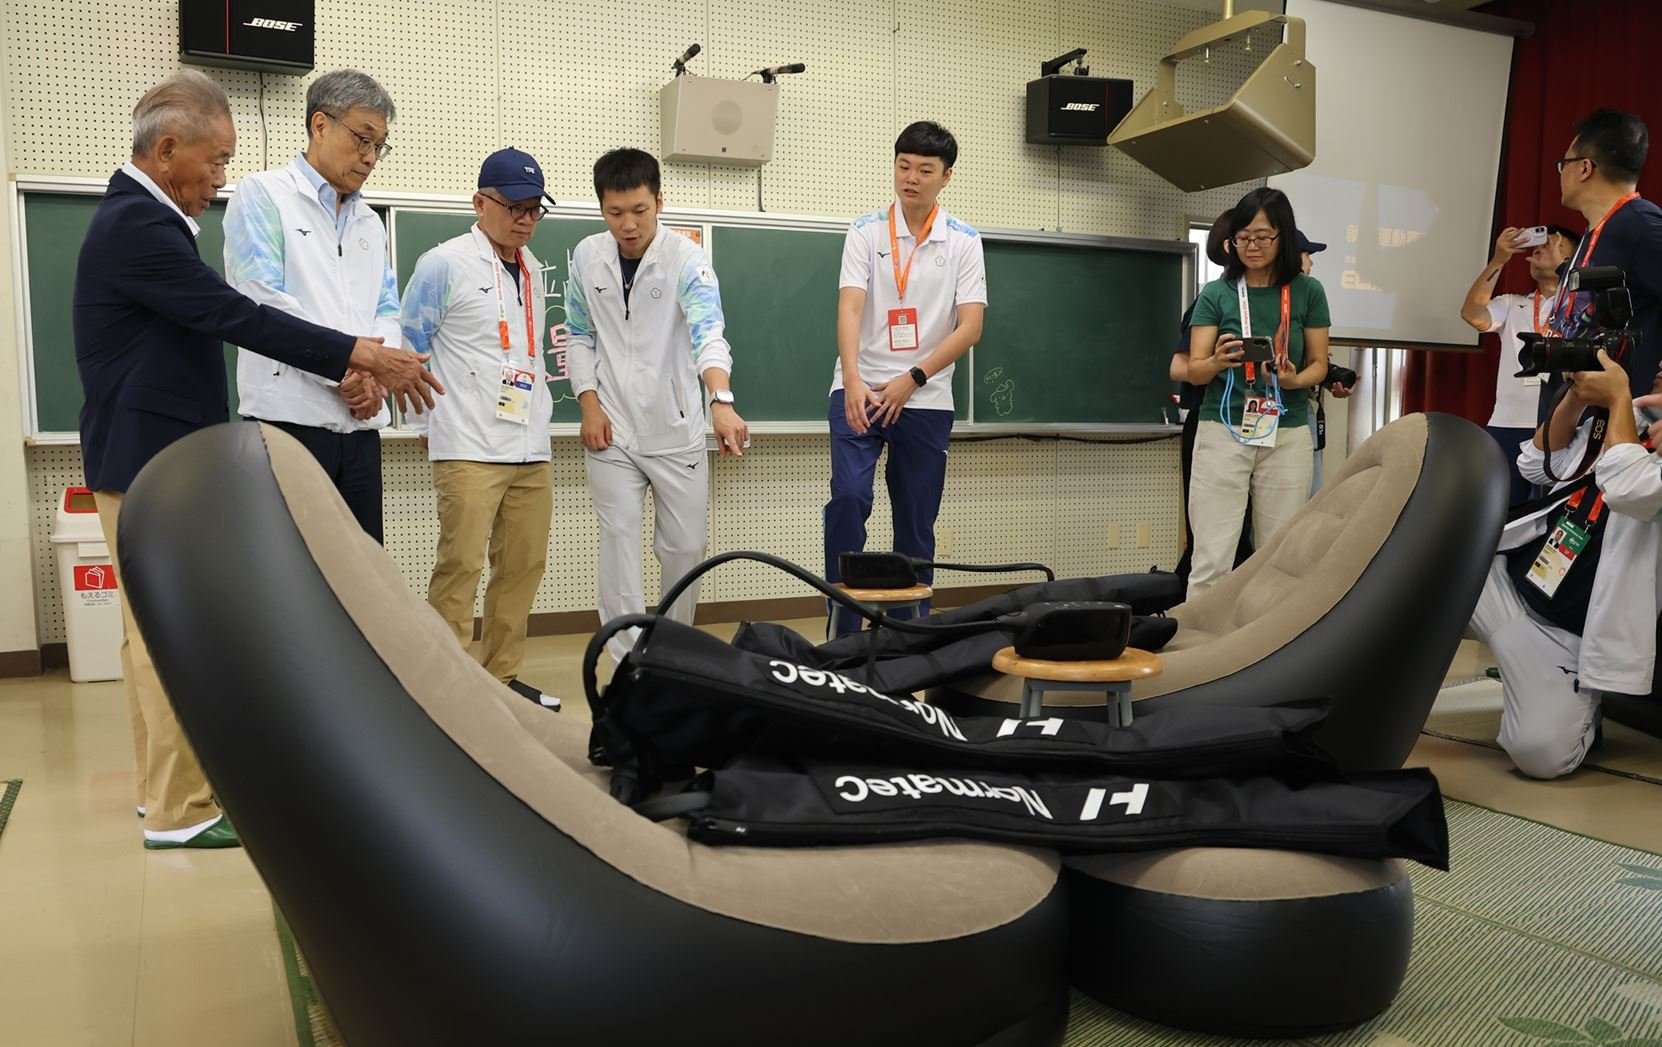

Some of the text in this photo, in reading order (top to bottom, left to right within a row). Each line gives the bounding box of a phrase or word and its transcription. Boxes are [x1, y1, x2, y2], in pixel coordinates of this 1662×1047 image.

[242, 17, 303, 32] BOSE
[1060, 102, 1100, 112] BOSE
[1592, 419, 1606, 440] EOS
[834, 773, 1054, 820] Normatec
